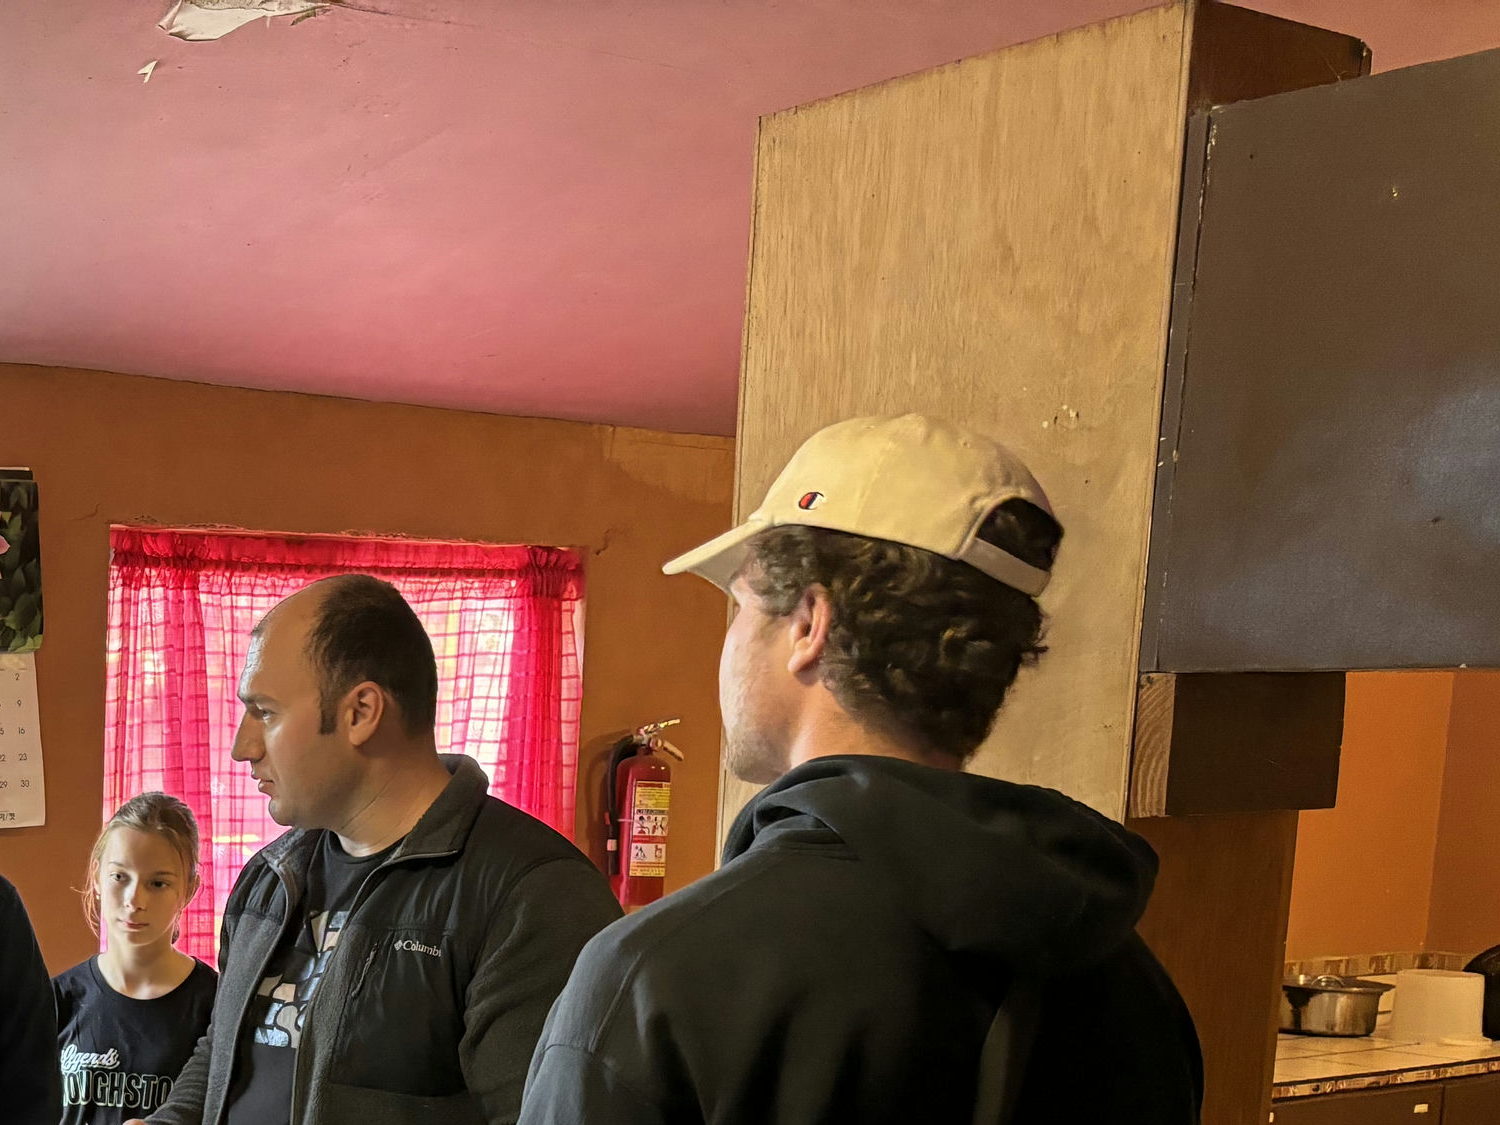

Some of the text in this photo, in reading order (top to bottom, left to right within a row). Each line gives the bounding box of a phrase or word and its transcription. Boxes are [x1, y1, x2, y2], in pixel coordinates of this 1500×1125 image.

[15, 672, 20, 681] 2
[17, 699, 22, 707] 9
[18, 726, 26, 735] 16
[18, 753, 28, 761] 23
[0, 780, 8, 789] 29
[20, 779, 30, 788] 30
[403, 940, 441, 957] Columbi
